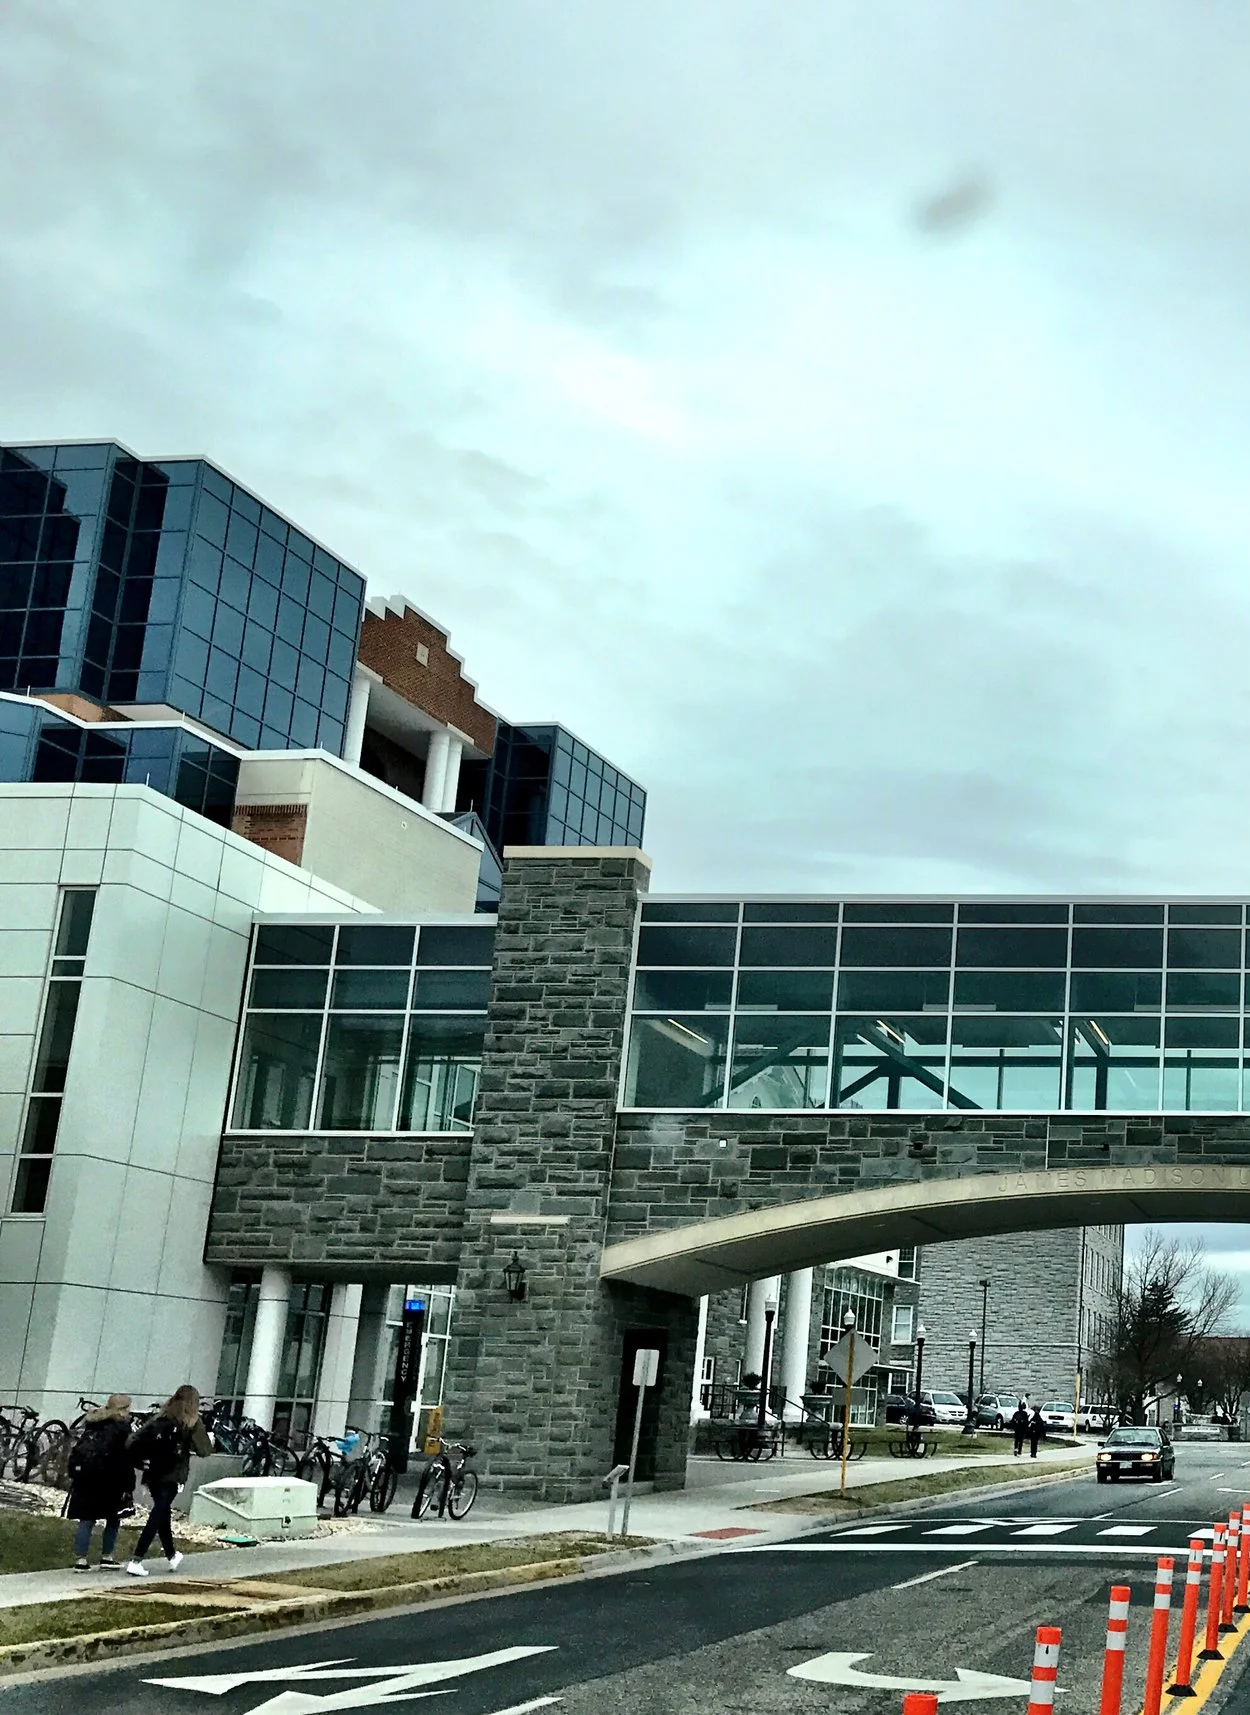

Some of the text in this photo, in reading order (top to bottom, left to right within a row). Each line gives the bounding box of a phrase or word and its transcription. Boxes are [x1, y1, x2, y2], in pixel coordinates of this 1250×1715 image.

[998, 1170, 1087, 1192] JAMES
[1100, 1168, 1225, 1185] MADISON
[401, 1321, 413, 1382] EMERGENCY
